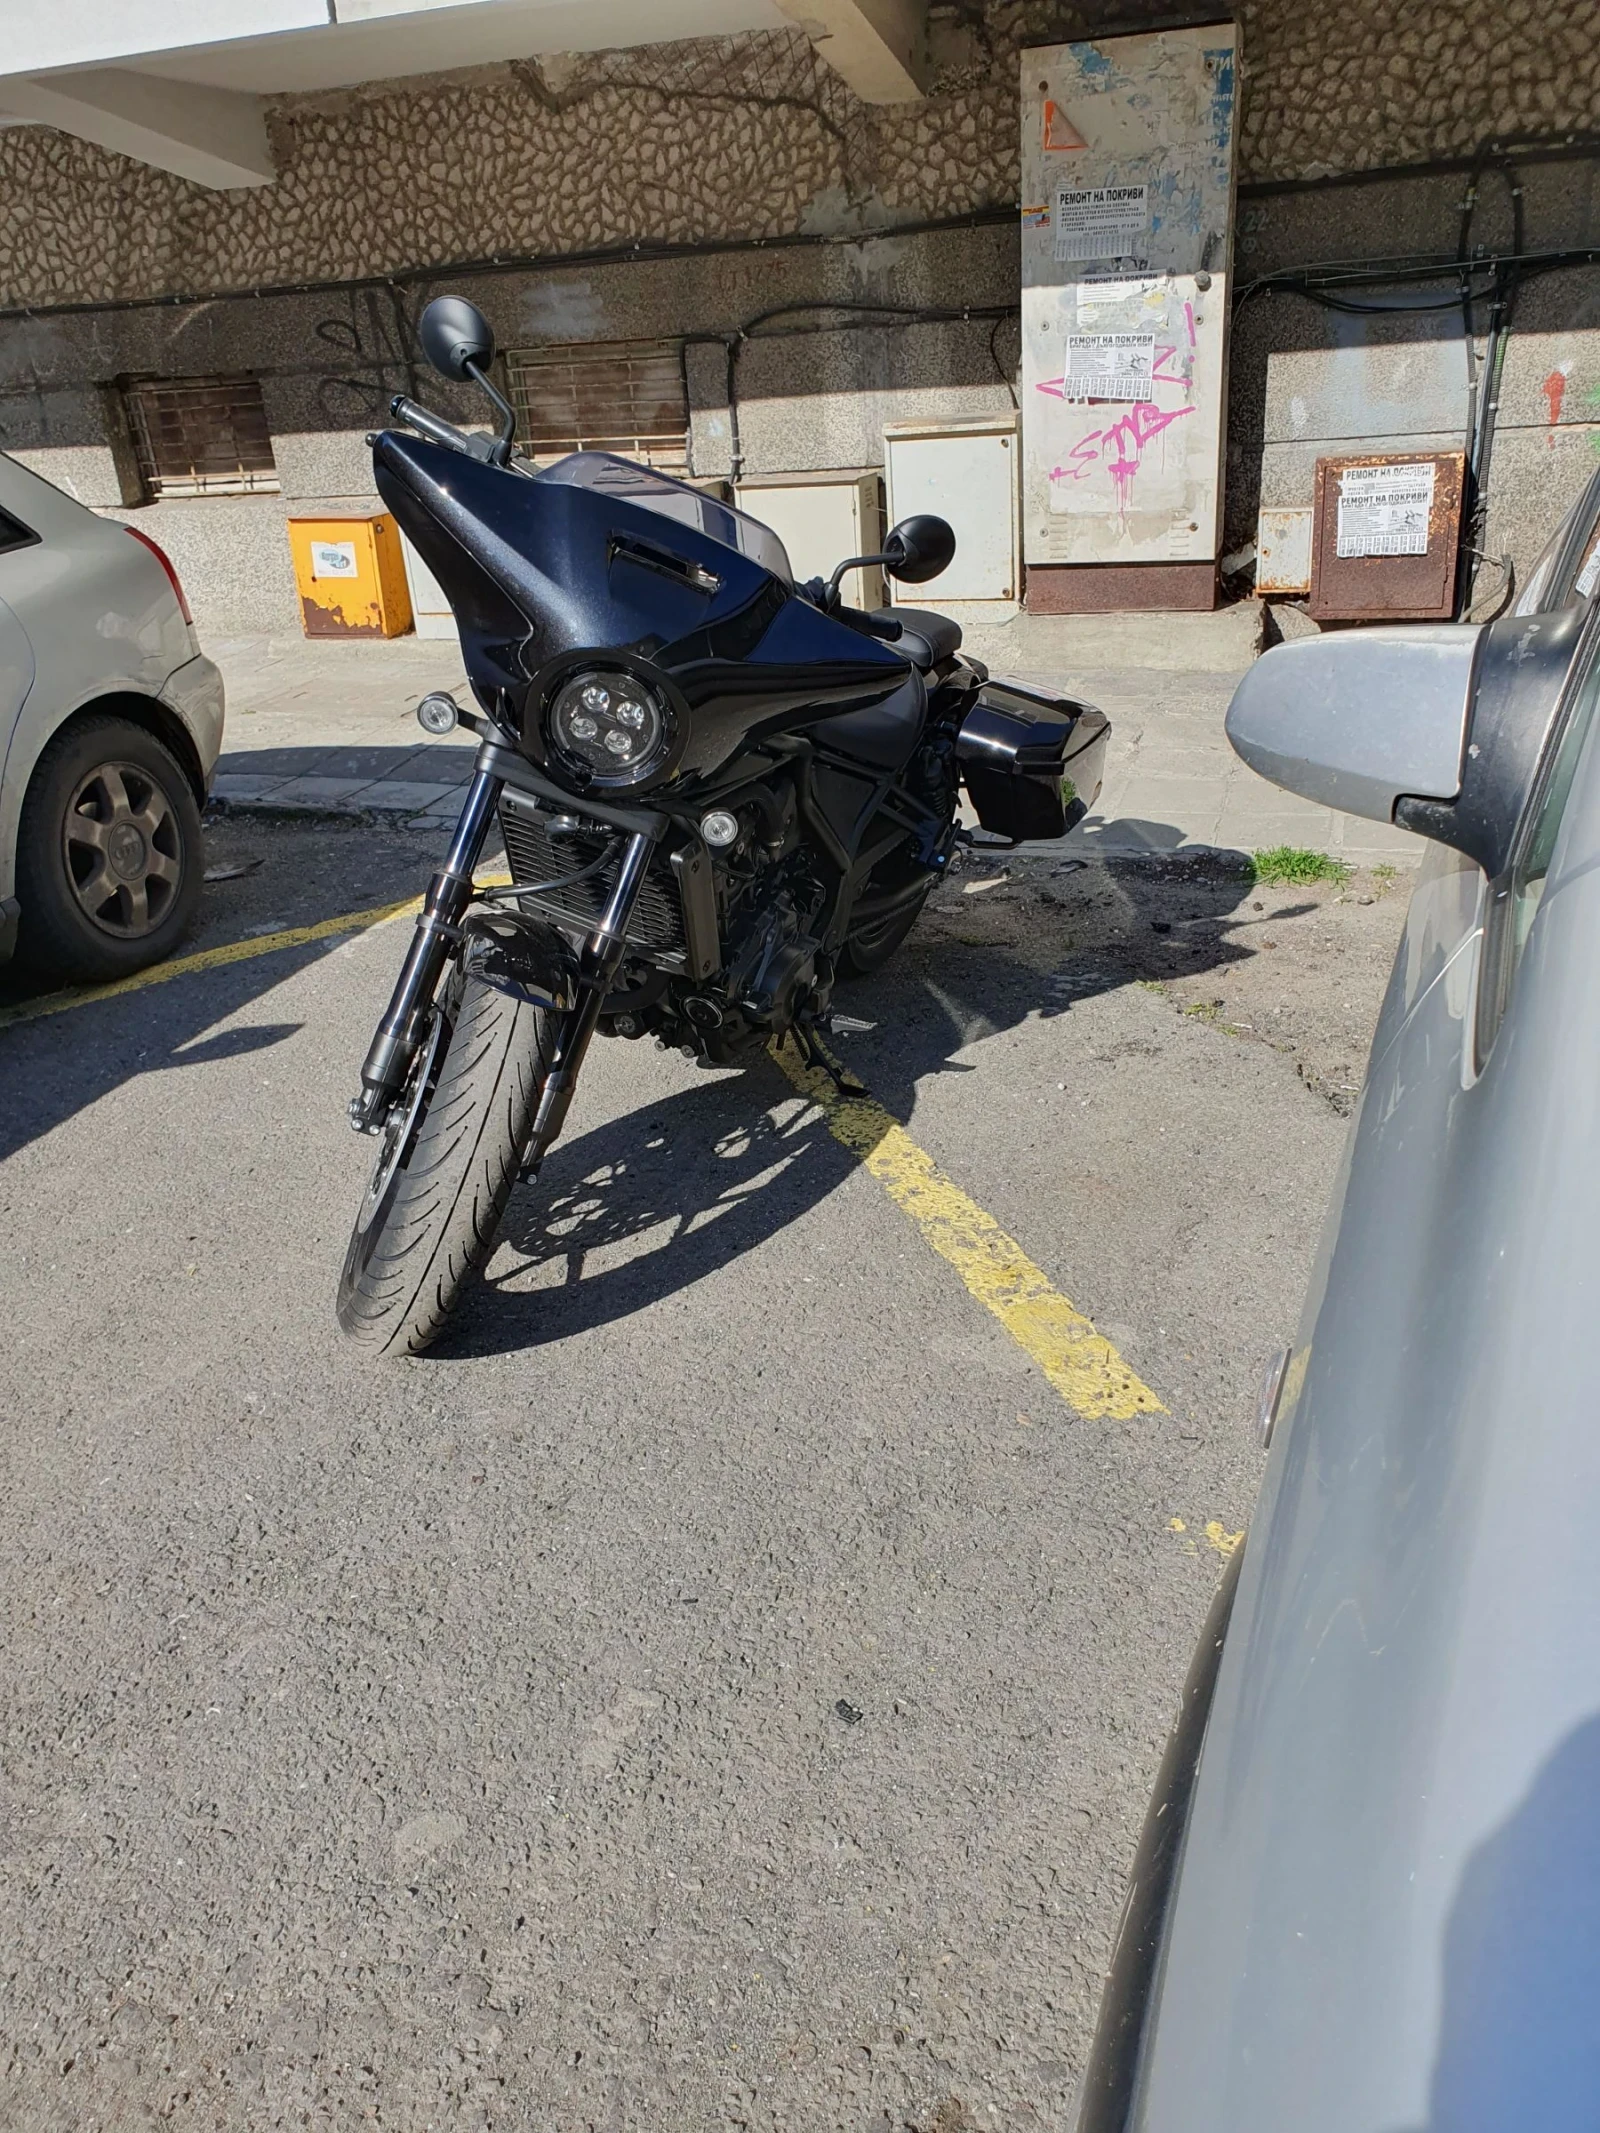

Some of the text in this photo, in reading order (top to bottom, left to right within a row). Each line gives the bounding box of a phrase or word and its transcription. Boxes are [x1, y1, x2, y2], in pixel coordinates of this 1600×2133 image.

[1060, 188, 1143, 205] РЕМОНТ НА ПОКРИВИ
[1084, 273, 1158, 285] РЕМОНТ НА ПОКРИВИ
[1069, 334, 1153, 345] РЕМОНТ НА ПОКРИВИ
[1346, 469, 1379, 480] РЕМОНТ
[1381, 468, 1391, 478] НА
[1341, 492, 1428, 505] РЕМОНТ НА ПОКРИВИ
